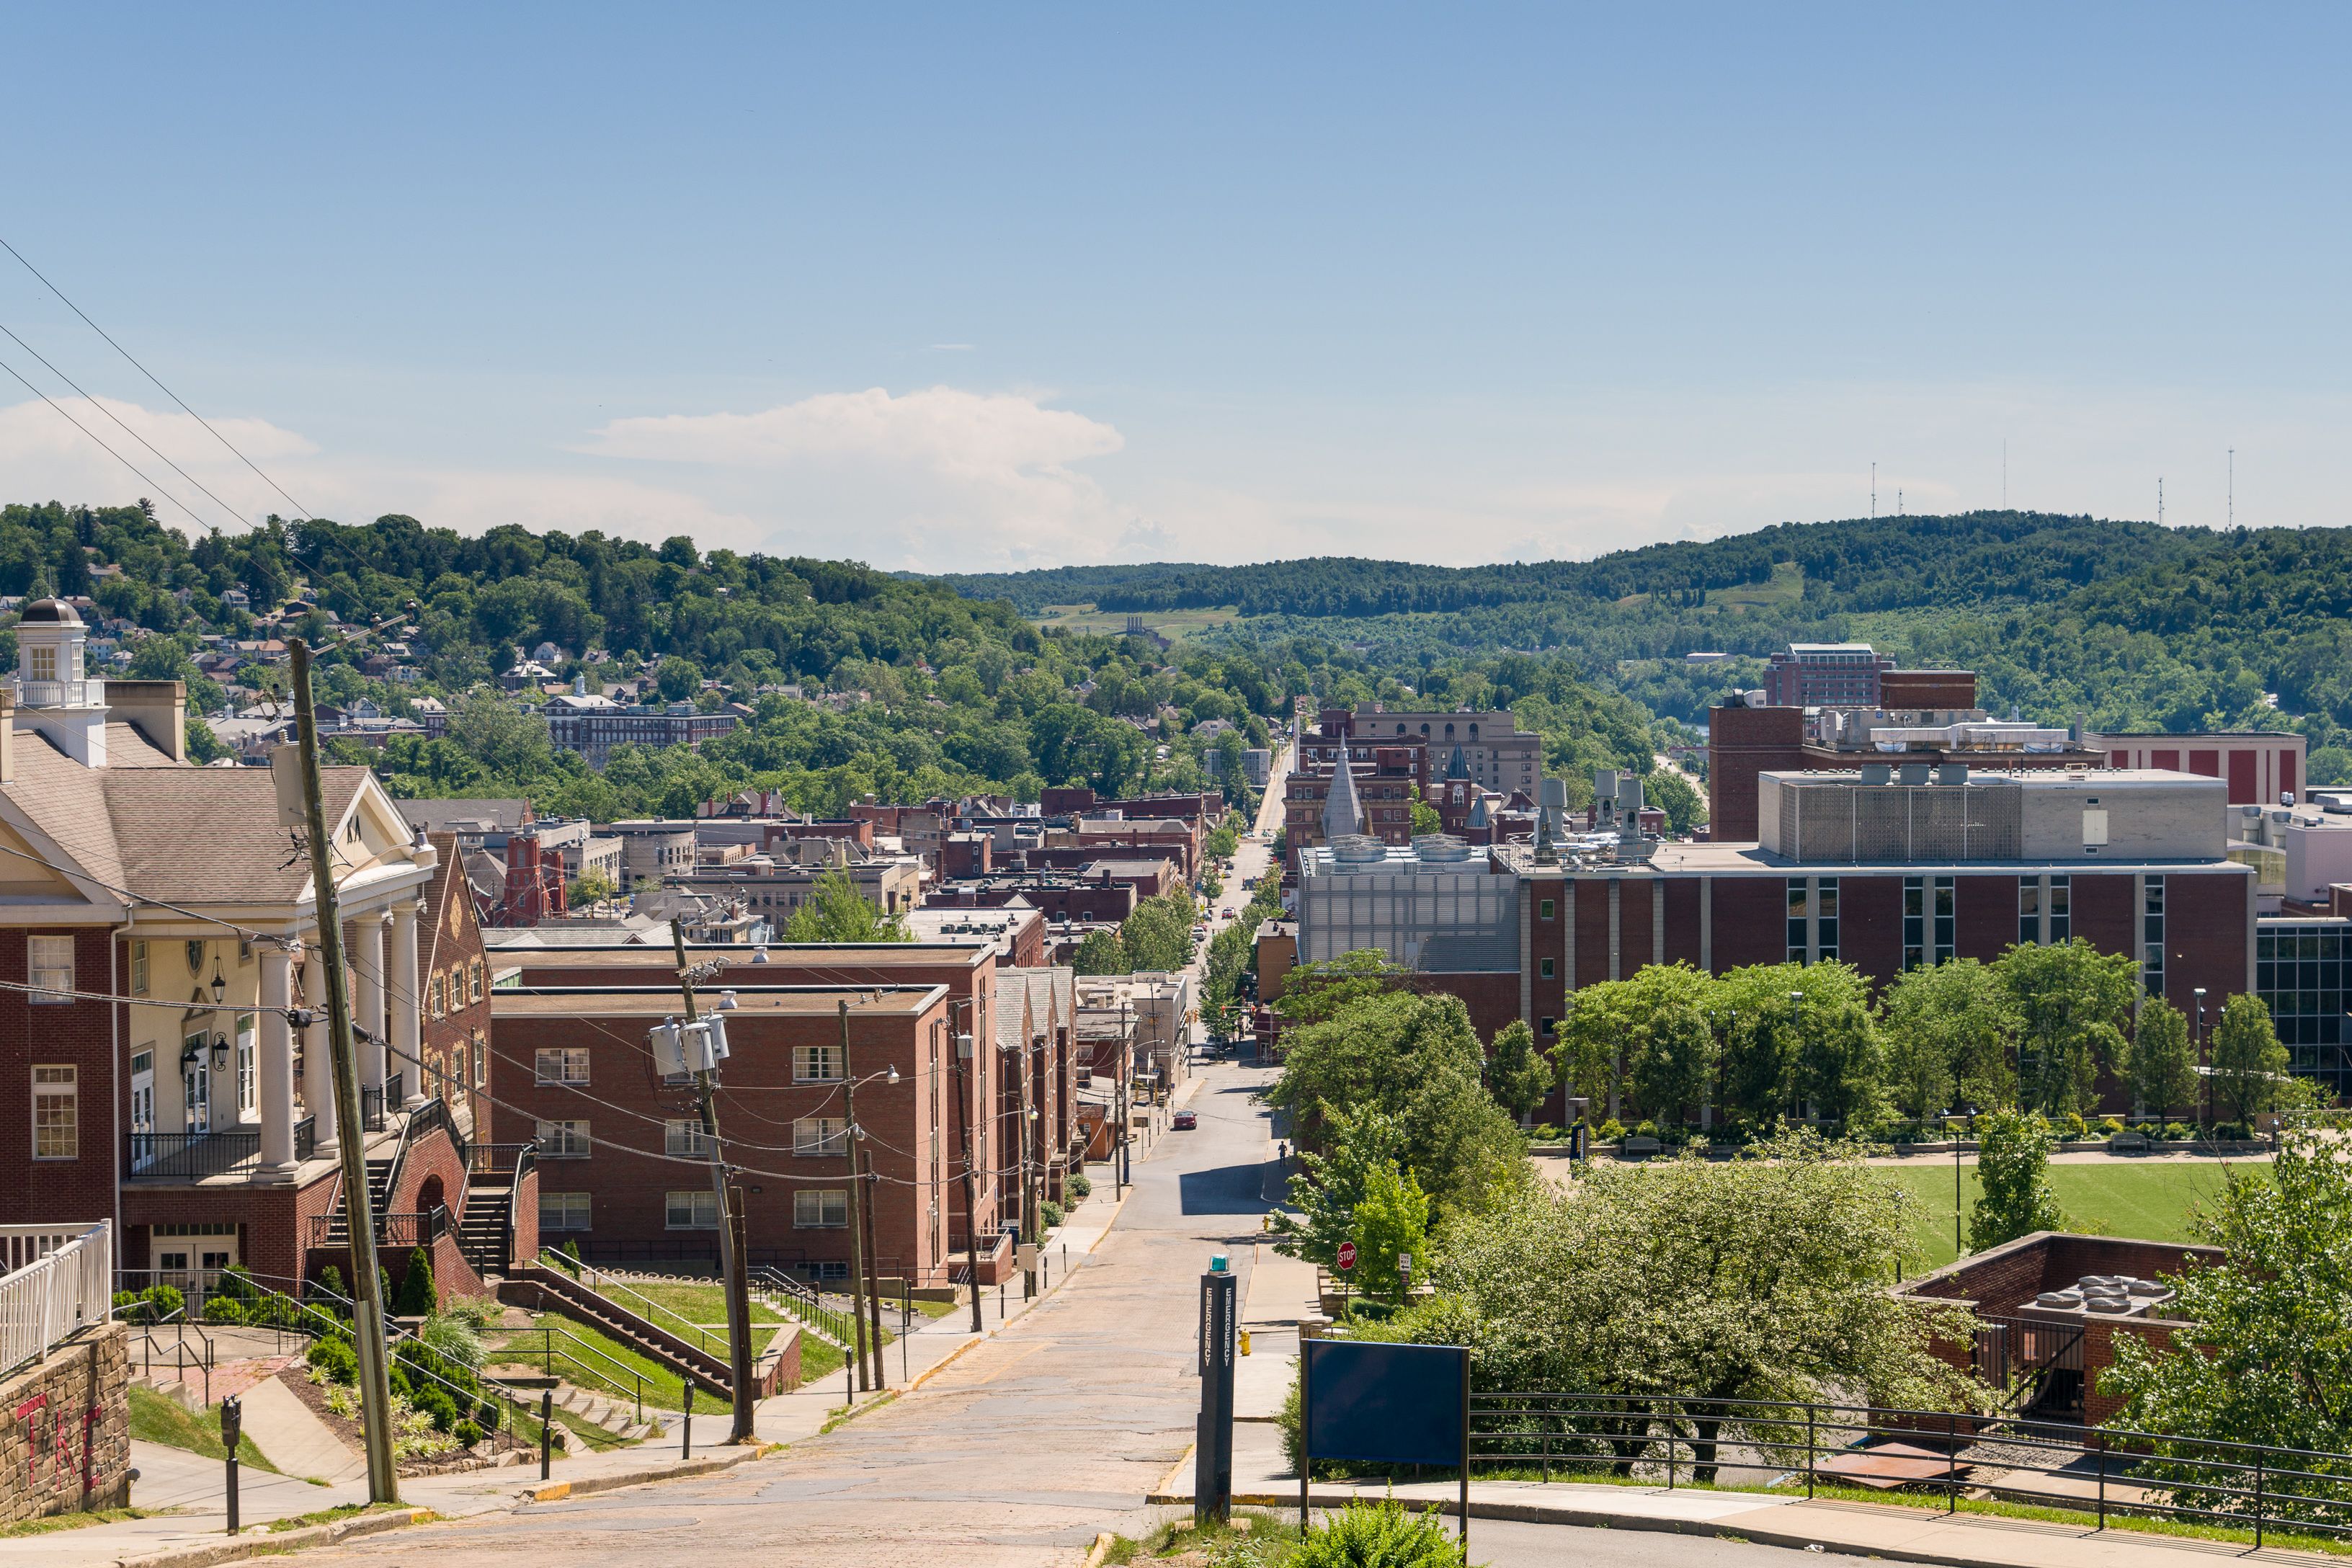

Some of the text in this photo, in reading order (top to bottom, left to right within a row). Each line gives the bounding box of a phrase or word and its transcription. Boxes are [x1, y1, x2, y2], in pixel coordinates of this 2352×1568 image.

[1339, 1249, 1355, 1262] STOP
[1204, 1287, 1213, 1367] EMERGENCY
[17, 1391, 102, 1494] TKE
